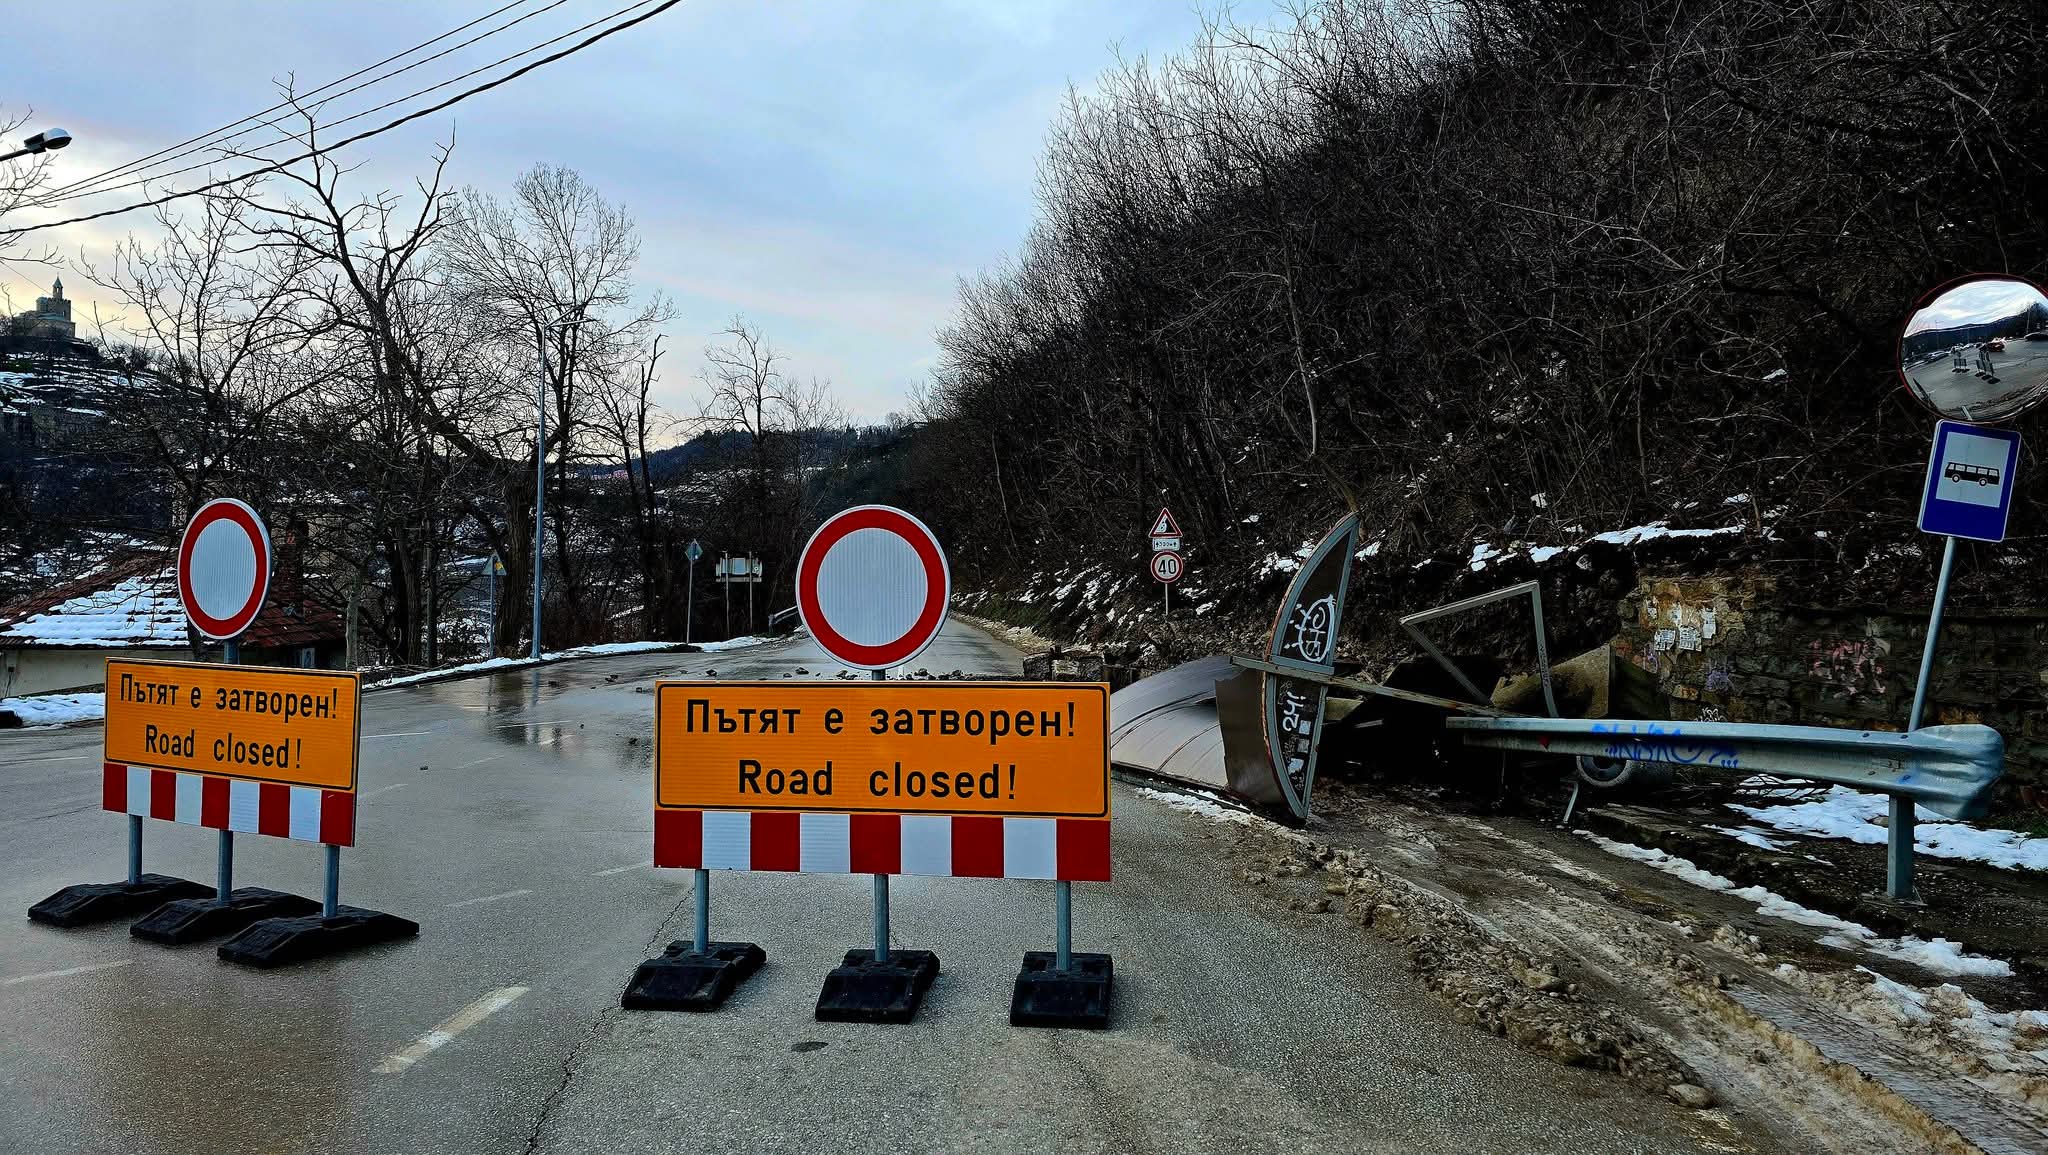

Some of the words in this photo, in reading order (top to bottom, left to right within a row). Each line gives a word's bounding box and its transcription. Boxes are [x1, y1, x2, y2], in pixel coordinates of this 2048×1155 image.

[1158, 559, 1177, 574] 40
[120, 673, 180, 707] Пътят
[190, 686, 202, 709] е
[215, 687, 339, 722] затворен!
[686, 698, 801, 734] Пътят
[824, 707, 844, 735] е
[869, 701, 1075, 745] затворен!
[145, 723, 195, 759] Road
[213, 732, 303, 769] closed!
[738, 759, 833, 796] Road
[869, 761, 1017, 799] closed!
